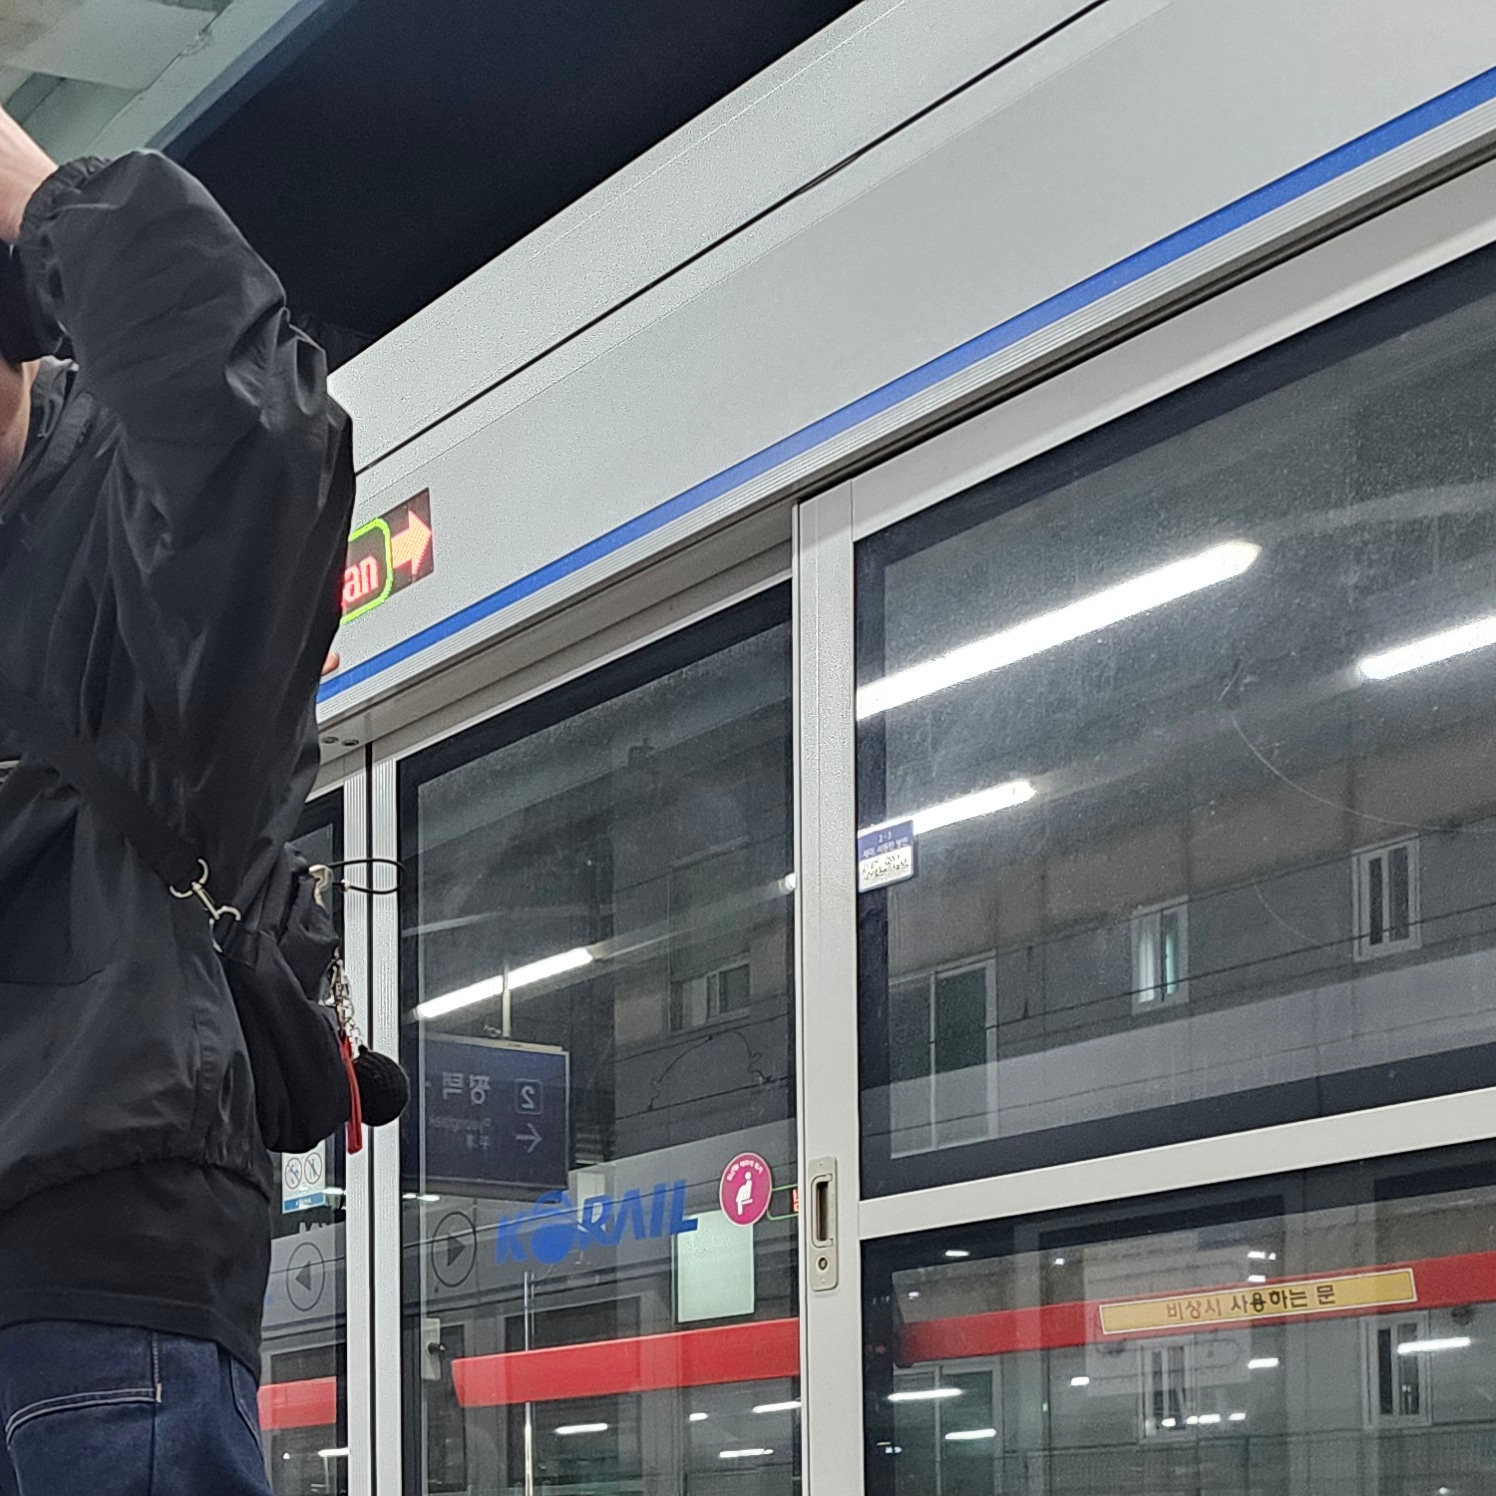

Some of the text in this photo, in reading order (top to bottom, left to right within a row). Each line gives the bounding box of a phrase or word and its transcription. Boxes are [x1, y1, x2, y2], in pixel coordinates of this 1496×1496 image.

[342, 555, 379, 603] an
[495, 1178, 699, 1266] KORAIL
[1166, 1284, 1336, 1321] 비상시 사용하는 문
